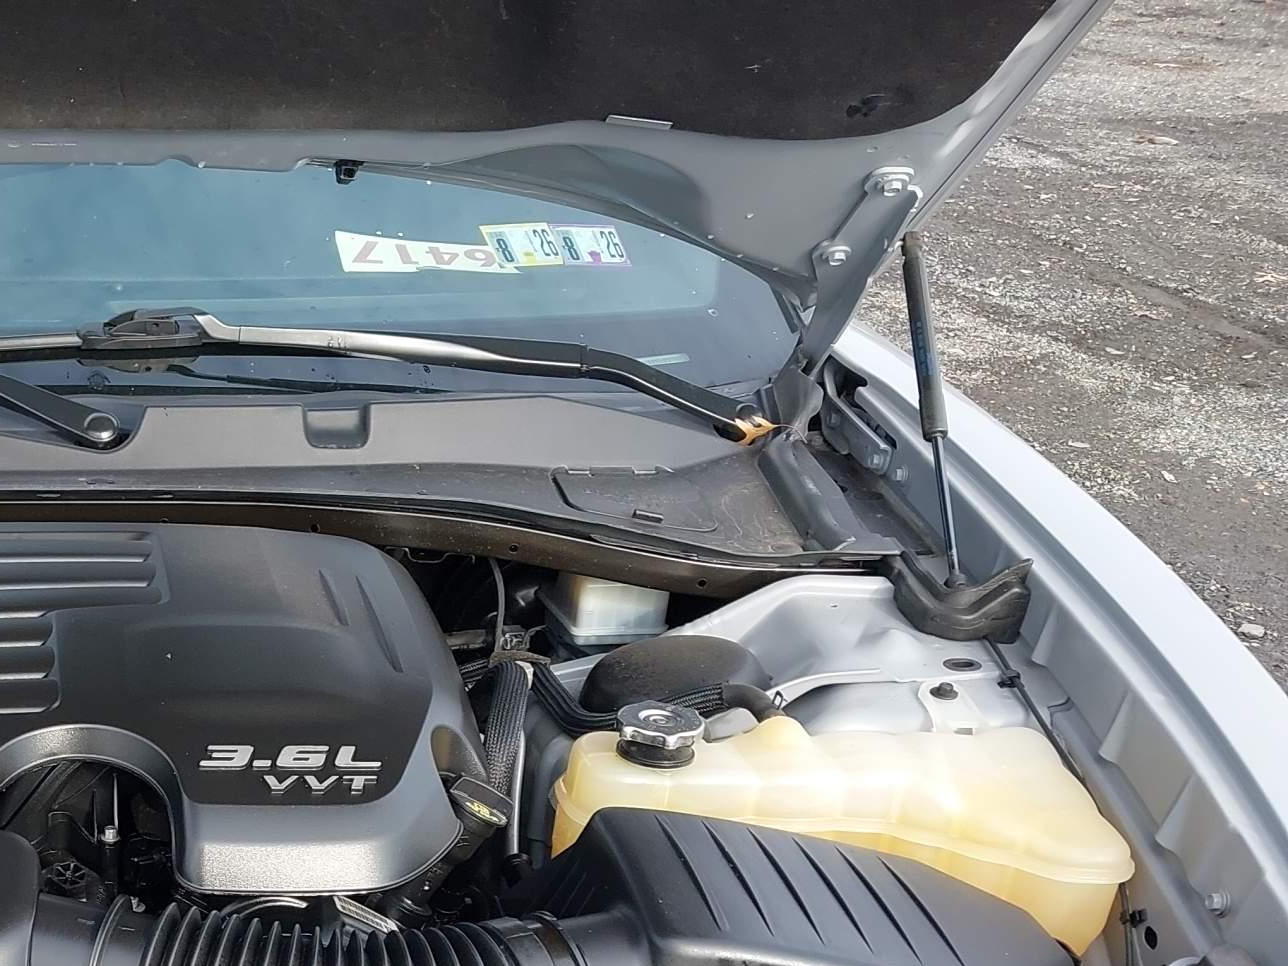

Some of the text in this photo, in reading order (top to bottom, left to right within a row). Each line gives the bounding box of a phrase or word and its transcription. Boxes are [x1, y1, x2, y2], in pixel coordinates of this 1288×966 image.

[532, 228, 560, 257] 26
[599, 230, 625, 259] 26
[198, 744, 383, 771] 3.6L
[262, 774, 379, 795] VVT
